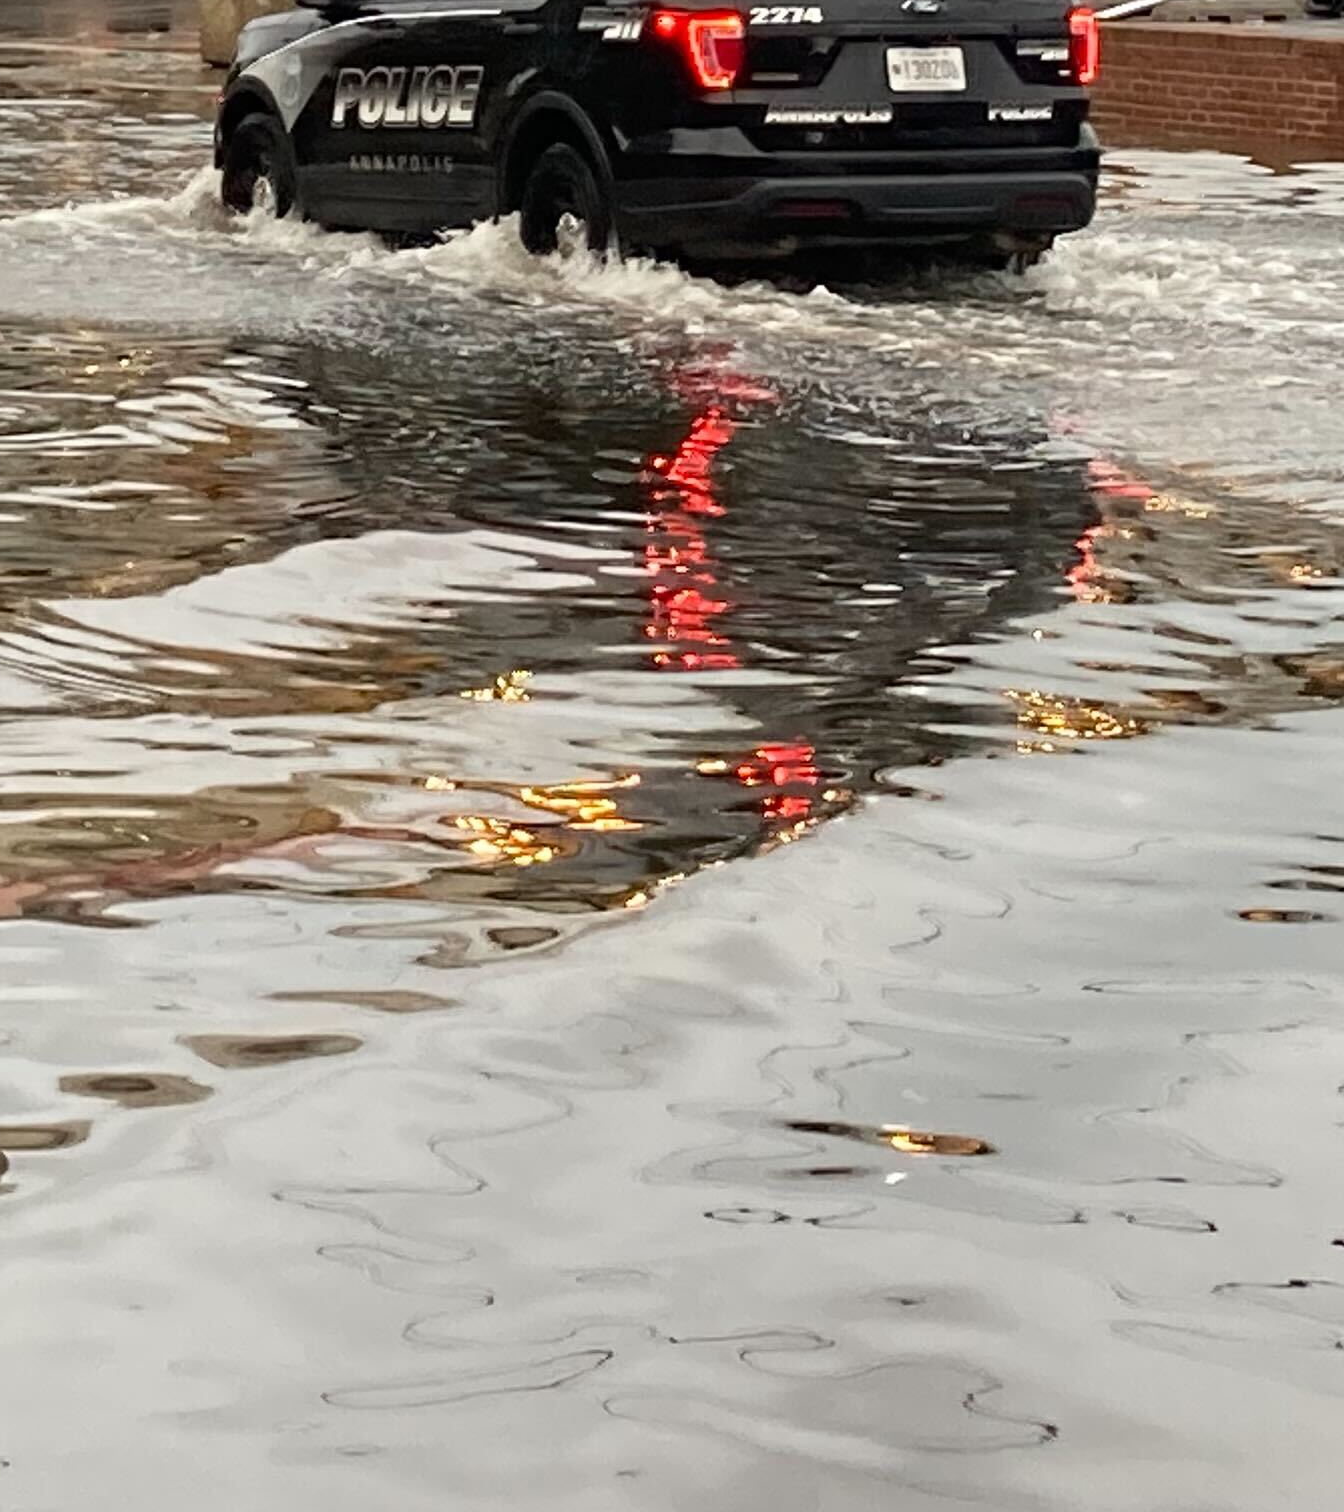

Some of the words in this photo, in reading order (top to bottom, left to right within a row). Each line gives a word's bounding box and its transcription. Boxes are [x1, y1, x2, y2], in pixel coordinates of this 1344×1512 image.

[749, 6, 825, 25] 2274
[330, 64, 485, 129] POLICE
[349, 153, 455, 174] ANNAPOLIS
